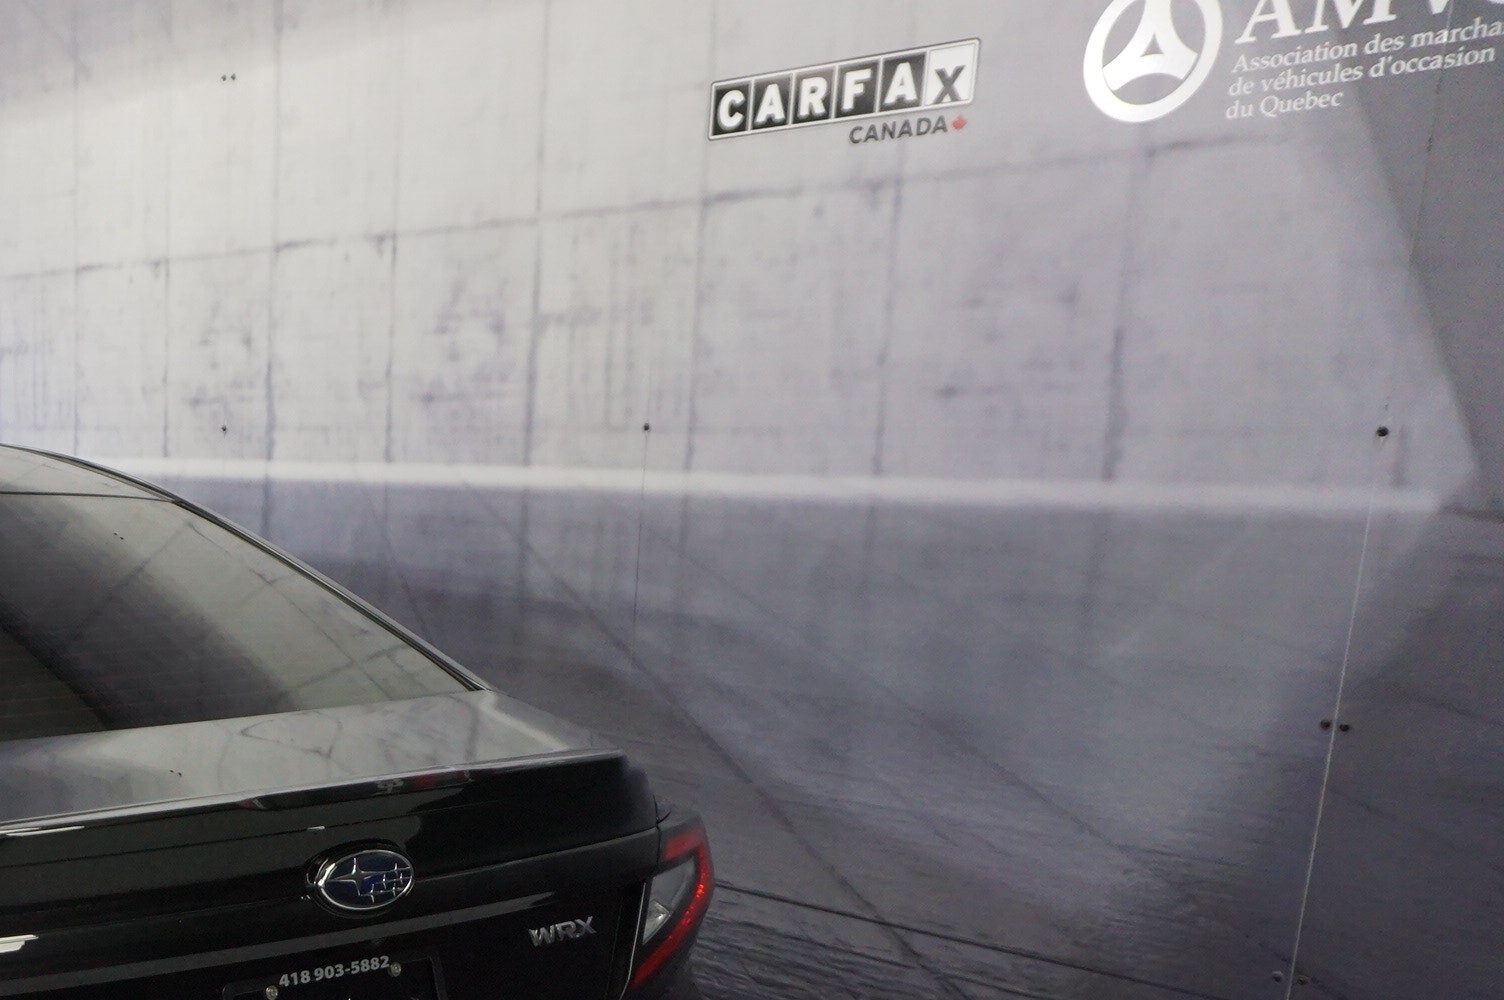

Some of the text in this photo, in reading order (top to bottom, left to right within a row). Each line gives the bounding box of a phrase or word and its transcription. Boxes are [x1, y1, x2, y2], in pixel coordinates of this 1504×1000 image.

[1231, 16, 1504, 74] Association des marcha
[1228, 46, 1495, 97] de véhicules d'occasion
[717, 62, 966, 131] CARFAX
[1225, 89, 1344, 119] du Quebec
[848, 115, 948, 144] CANADA
[528, 915, 597, 948] WRX
[279, 955, 390, 987] 418 903-5882
